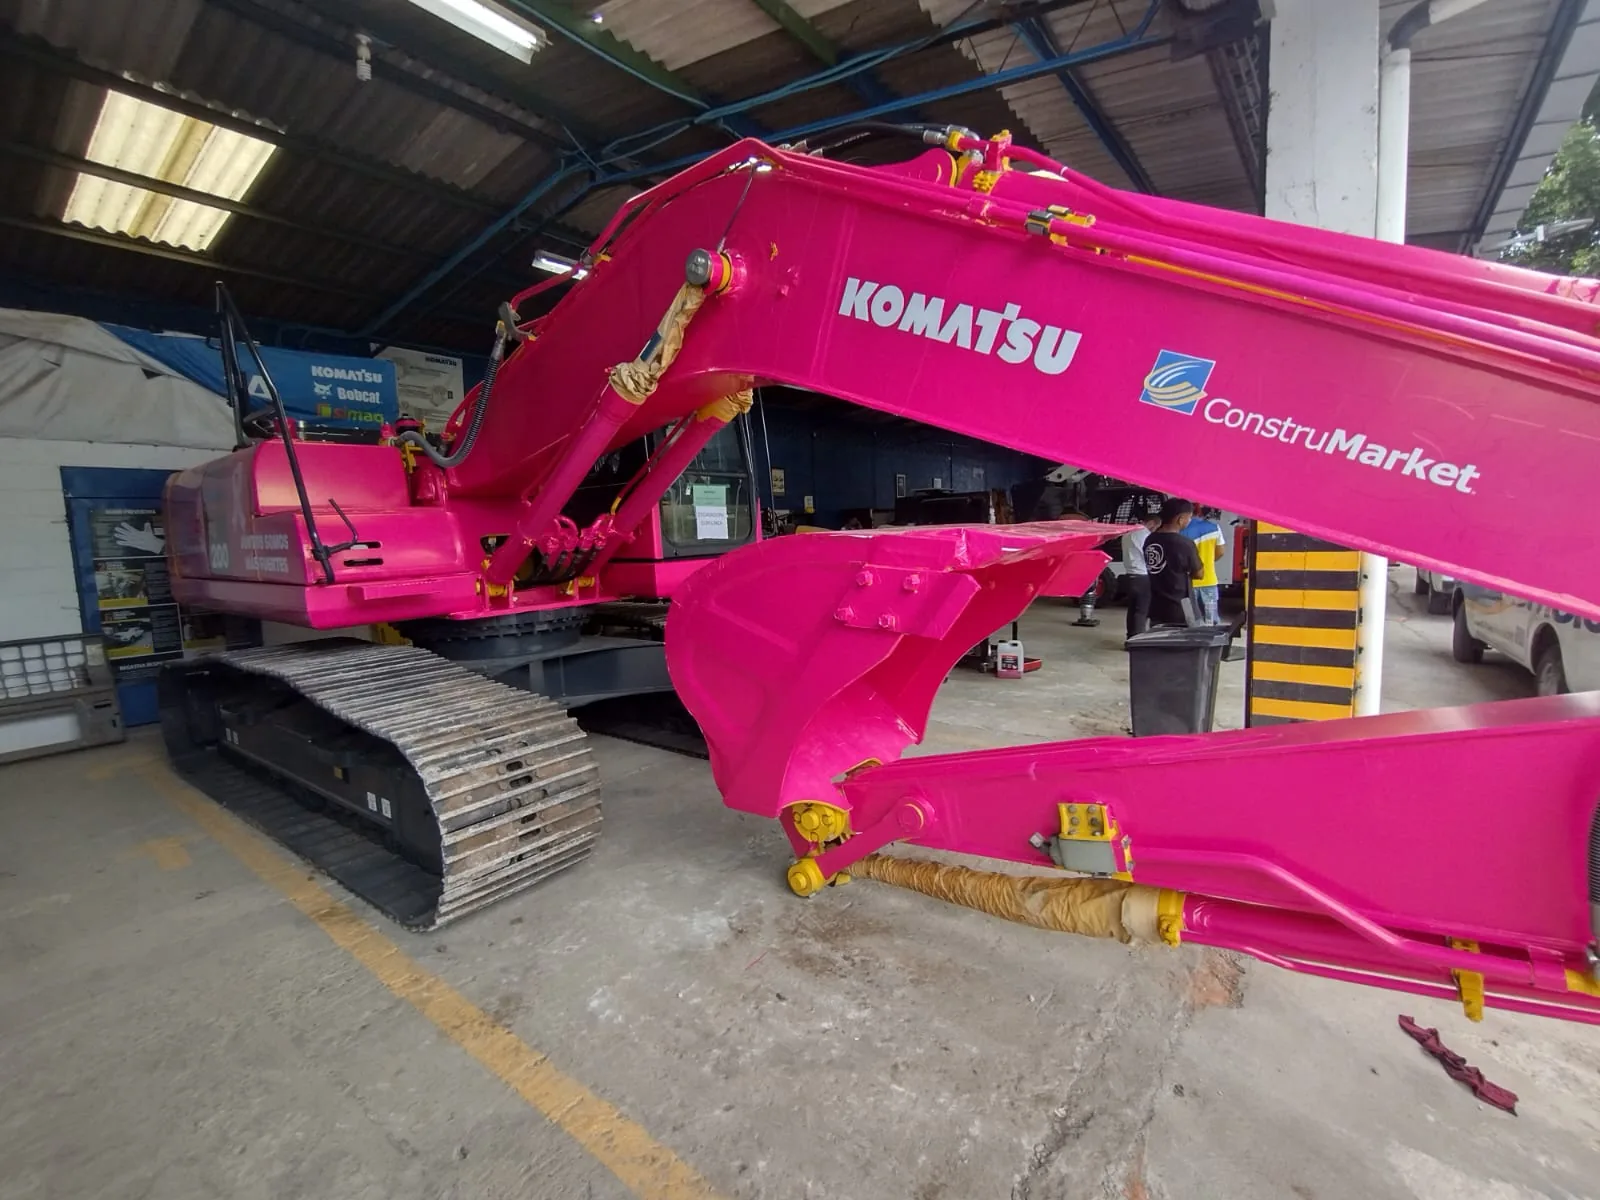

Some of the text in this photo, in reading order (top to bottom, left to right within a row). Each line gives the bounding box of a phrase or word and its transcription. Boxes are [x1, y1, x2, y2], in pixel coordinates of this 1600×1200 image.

[838, 277, 1083, 375] KOMATSU
[311, 365, 383, 384] KOMATSU
[337, 387, 380, 404] Bobcat
[1203, 398, 1480, 494] ConstruMarket
